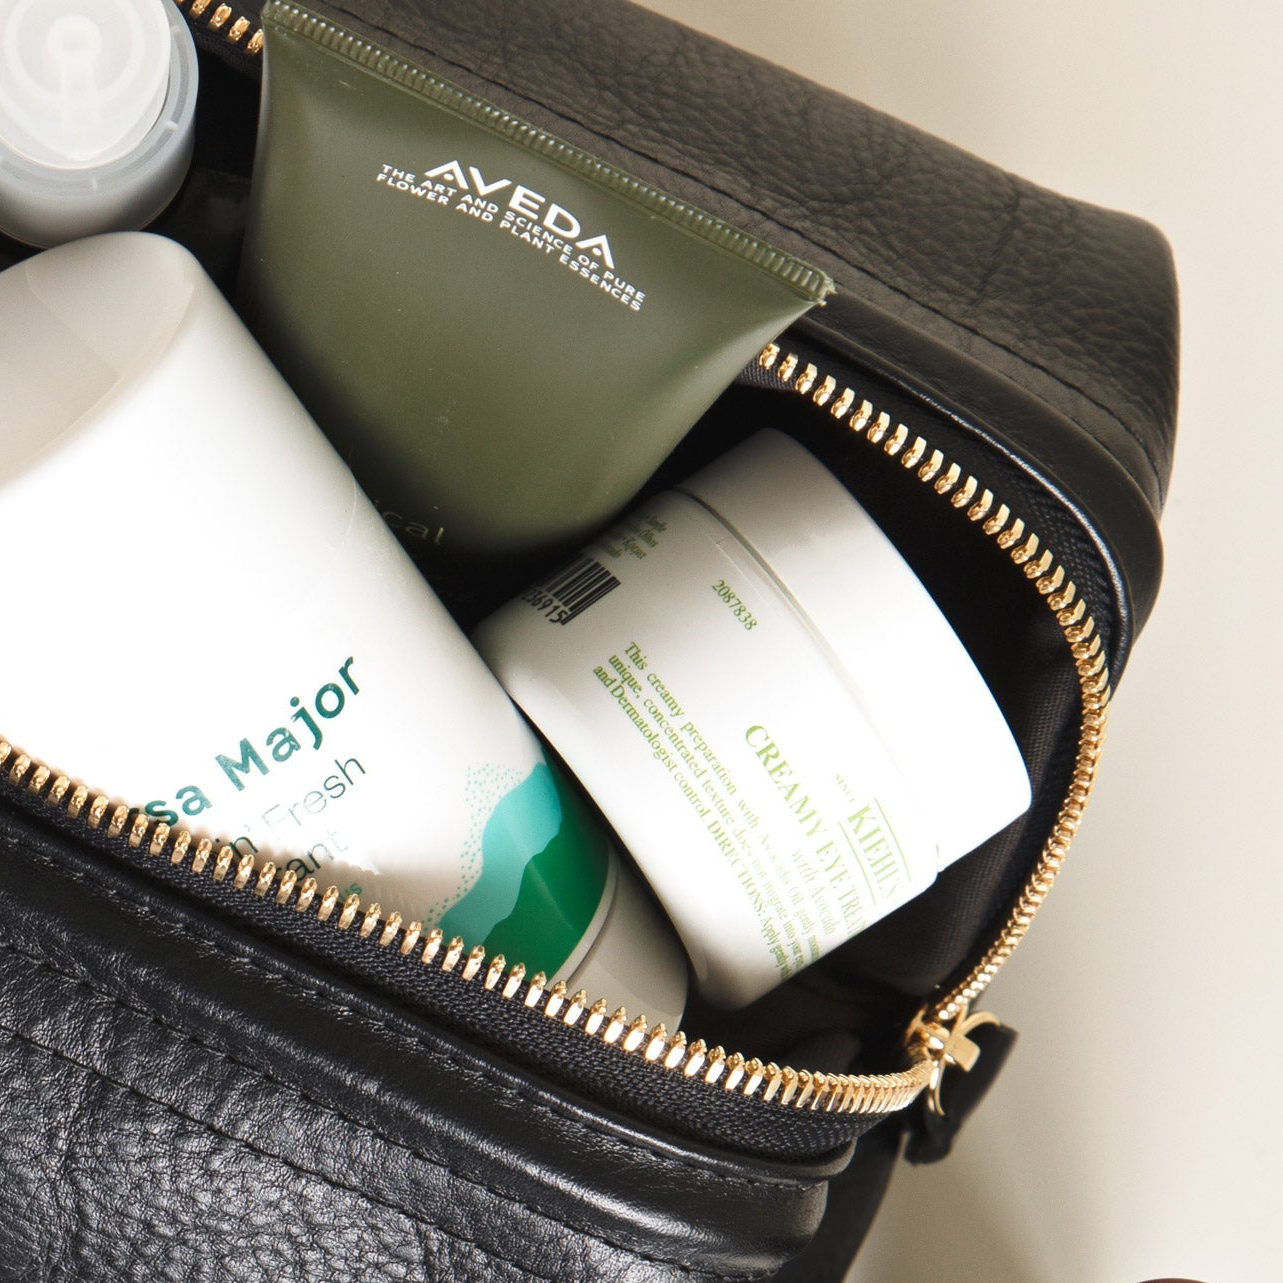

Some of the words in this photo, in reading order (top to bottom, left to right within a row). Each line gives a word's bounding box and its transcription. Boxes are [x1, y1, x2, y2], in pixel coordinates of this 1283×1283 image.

[375, 172, 451, 207] FLOWER
[455, 203, 495, 223] AND
[499, 220, 555, 255] PLANT
[558, 254, 643, 313] ESSENCES
[380, 163, 416, 183] THE
[420, 178, 458, 197] ART
[460, 193, 499, 214] AND
[503, 210, 575, 256] SCIENCE
[577, 254, 600, 272] OF
[603, 270, 647, 303] PURE
[423, 159, 615, 269] AVEDA
[711, 579, 758, 631] 2087838
[214, 655, 360, 792] Major
[593, 665, 616, 688] and
[609, 677, 678, 774] Dermatologist
[674, 771, 708, 823] control.
[706, 819, 767, 918] DIRECTIONS:
[608, 654, 643, 699] unique,
[643, 697, 706, 780] concentrated
[701, 774, 735, 826] texture
[624, 641, 649, 670] This
[647, 672, 685, 718] creamy
[681, 720, 738, 797] preparation
[738, 799, 759, 831] with
[260, 757, 366, 842] Fresh
[744, 723, 829, 838] CREAMY
[815, 839, 849, 889] EYE
